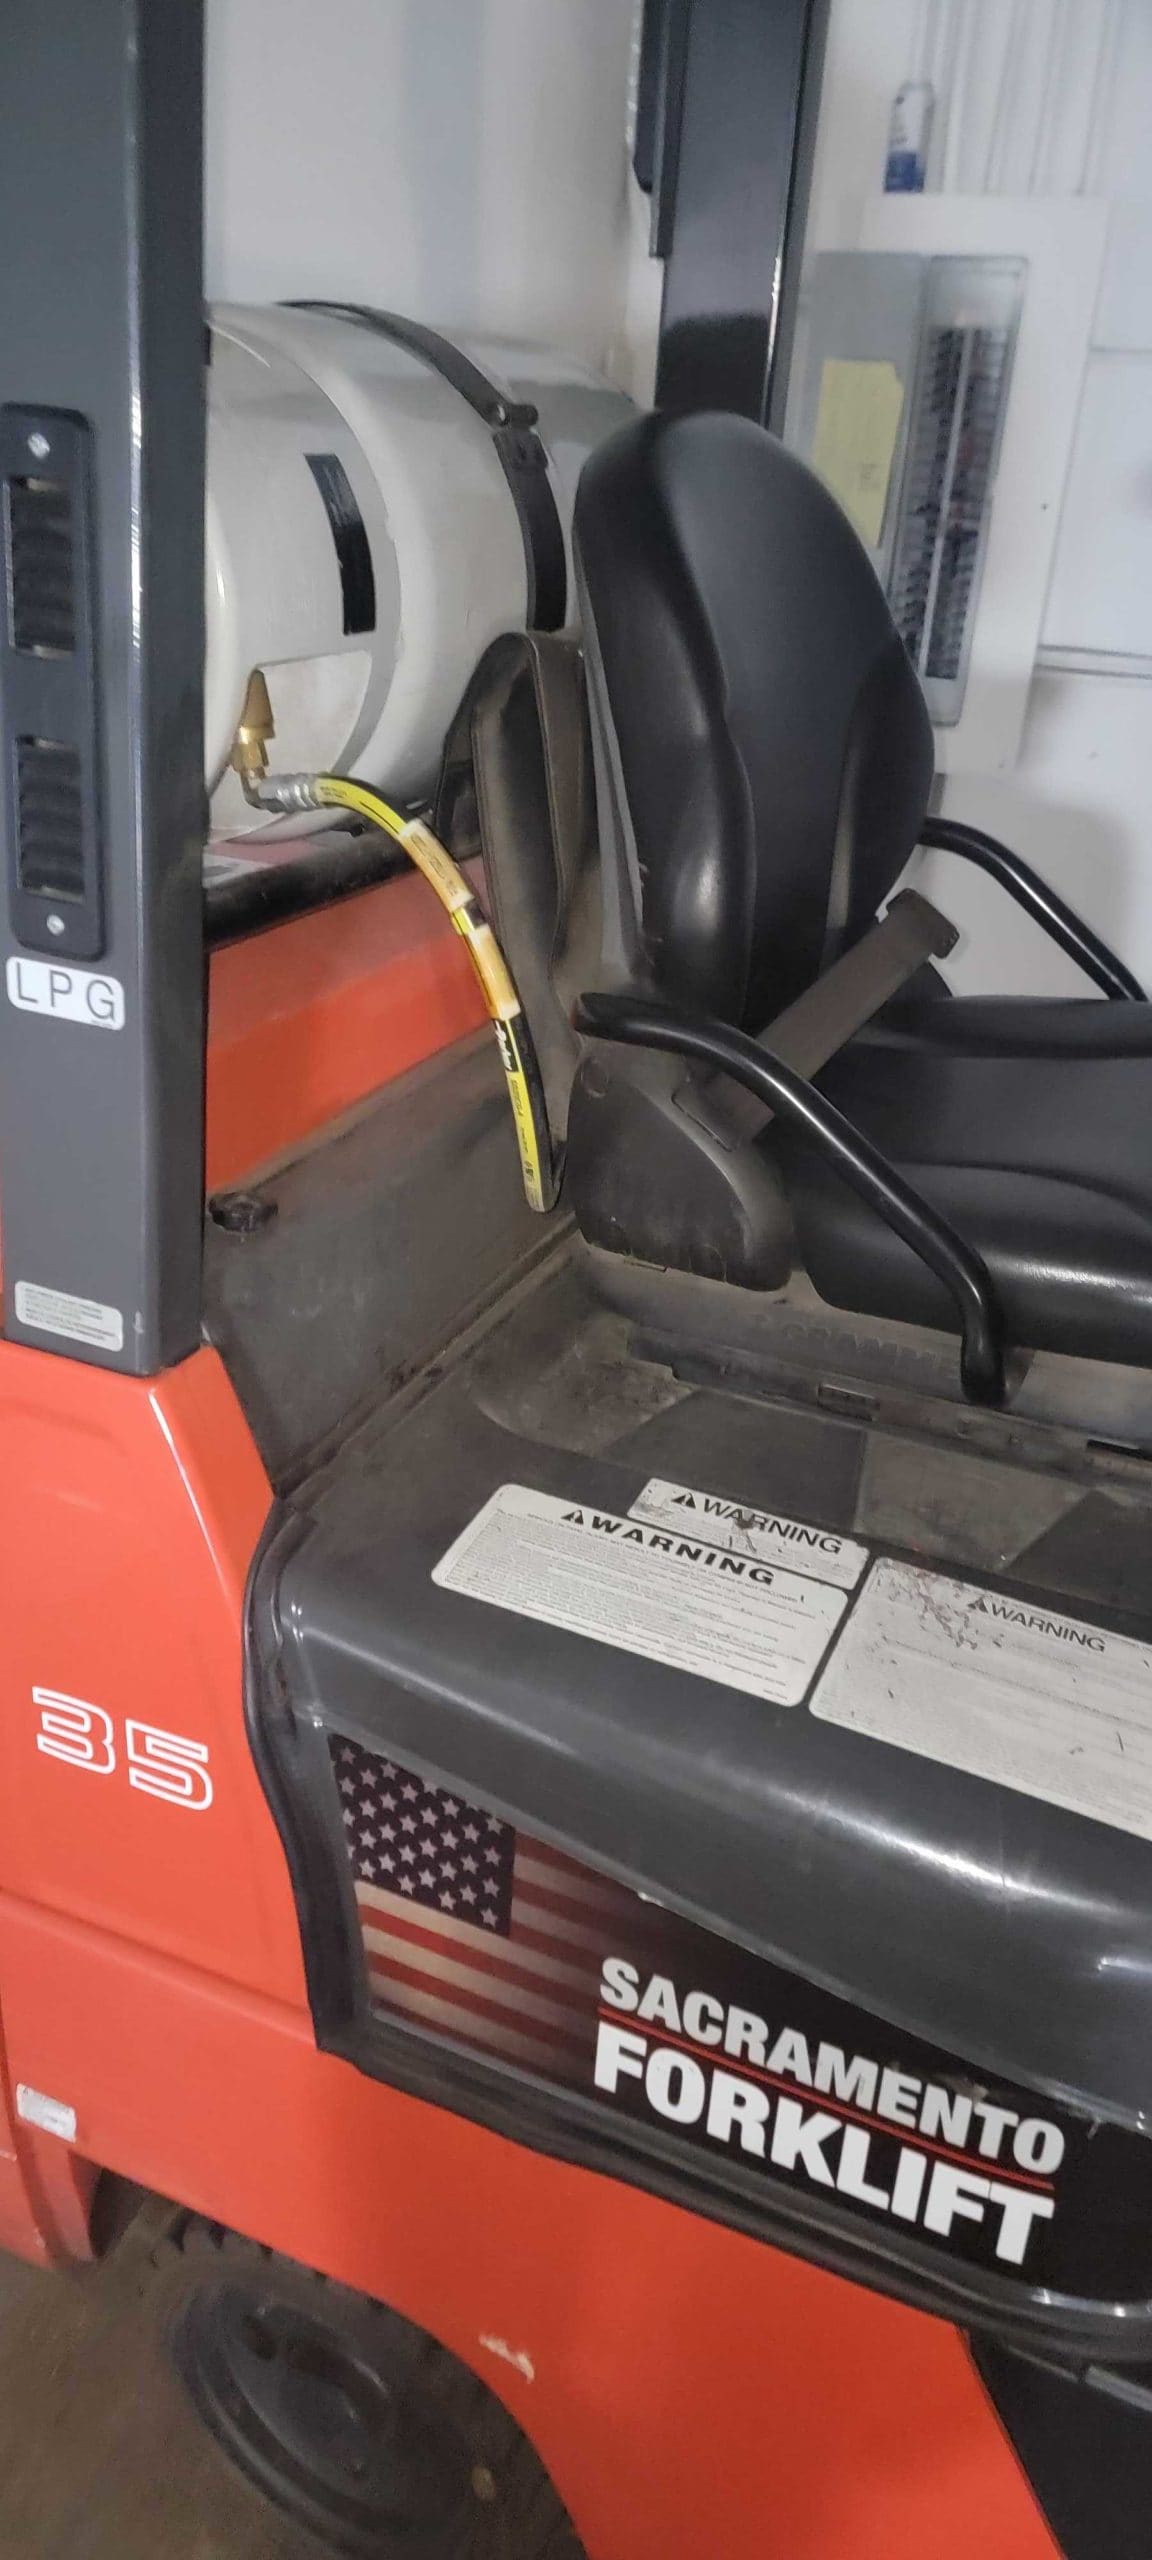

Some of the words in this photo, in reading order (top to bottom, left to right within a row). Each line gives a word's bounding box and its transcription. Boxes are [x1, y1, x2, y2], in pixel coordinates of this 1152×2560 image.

[17, 961, 116, 1022] LPG
[591, 1515, 775, 1586] WARNING
[703, 1498, 843, 1555] WARNING
[991, 1602, 1107, 1653] WARNING
[31, 1685, 214, 1811] 35
[599, 1956, 1065, 2175] SACRAMENTO
[593, 2020, 1056, 2266] FORKLIFT
